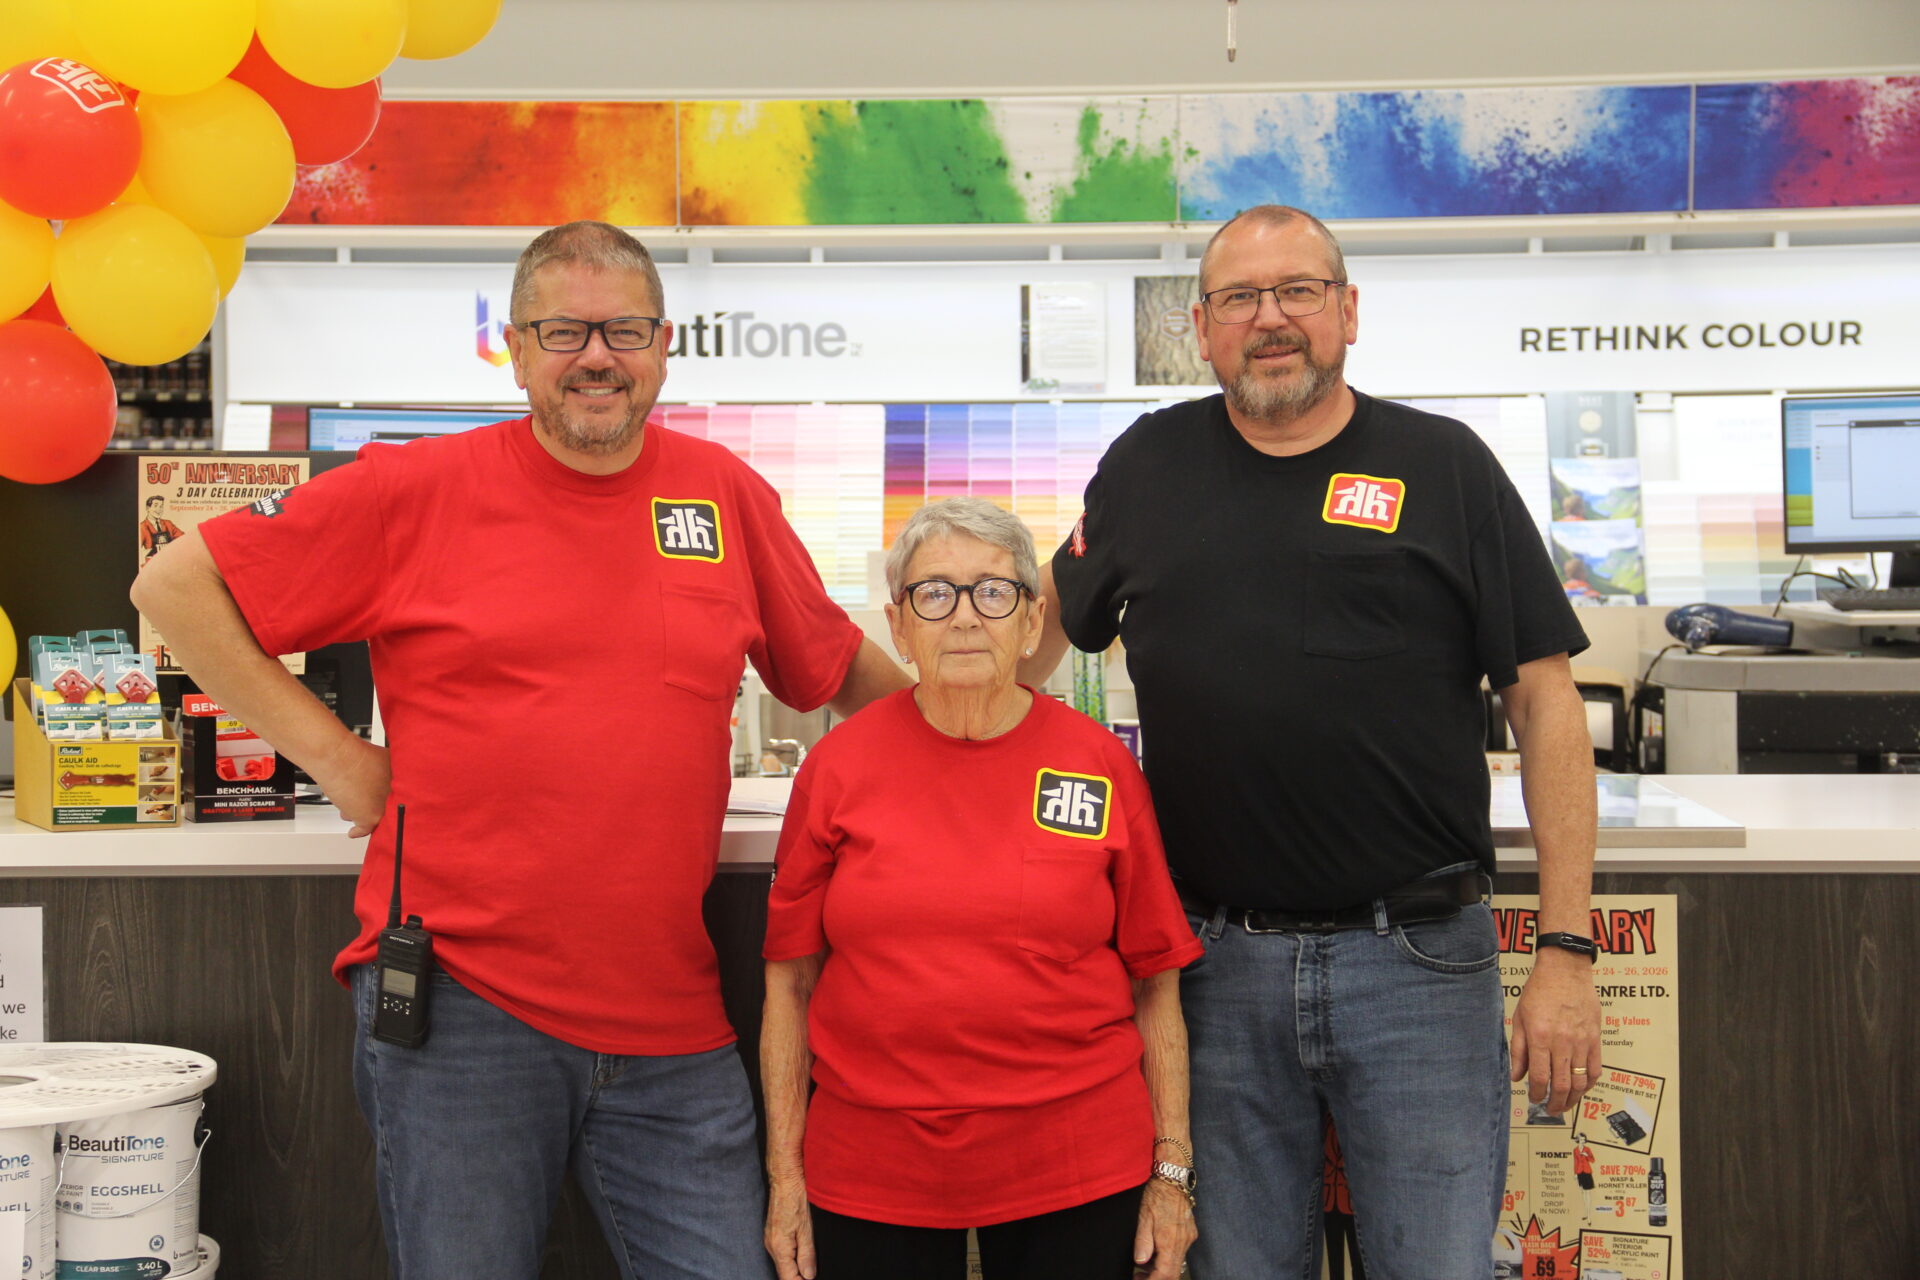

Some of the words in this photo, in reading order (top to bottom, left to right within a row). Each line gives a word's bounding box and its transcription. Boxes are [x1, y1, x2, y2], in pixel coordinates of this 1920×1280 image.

[1519, 323, 1690, 353] RETHINK
[1702, 320, 1863, 349] COLOUR
[185, 462, 300, 486] ANNIVERSARY
[176, 487, 184, 498] 3
[187, 487, 207, 498] DAY
[191, 702, 223, 713] BEN
[216, 786, 273, 795] BENCHMARK
[1602, 967, 1615, 976] 24
[1642, 967, 1669, 976] 2026
[1640, 985, 1670, 998] LTD.
[3, 1002, 26, 1014] we
[1605, 1016, 1620, 1027] Big
[1622, 1016, 1651, 1026] Values
[0, 1025, 18, 1040] ke
[1602, 1039, 1634, 1048] Saturday
[1609, 1071, 1632, 1085] SAVE
[1632, 1076, 1656, 1090] 79%
[1610, 1083, 1634, 1095] DRIVER
[1645, 1092, 1658, 1100] SET
[69, 1135, 165, 1152] BeautiTone
[100, 1152, 164, 1164] SIGNATURE
[1600, 1165, 1620, 1176] SAVE
[1623, 1165, 1646, 1176] 70%
[90, 1183, 165, 1197] EGGSHELL
[1615, 1200, 1625, 1217] 3
[1583, 1236, 1605, 1247] SAVE
[1587, 1247, 1611, 1259] 52%
[136, 1261, 156, 1272] 3.40
[1532, 1260, 1556, 1277] .69
